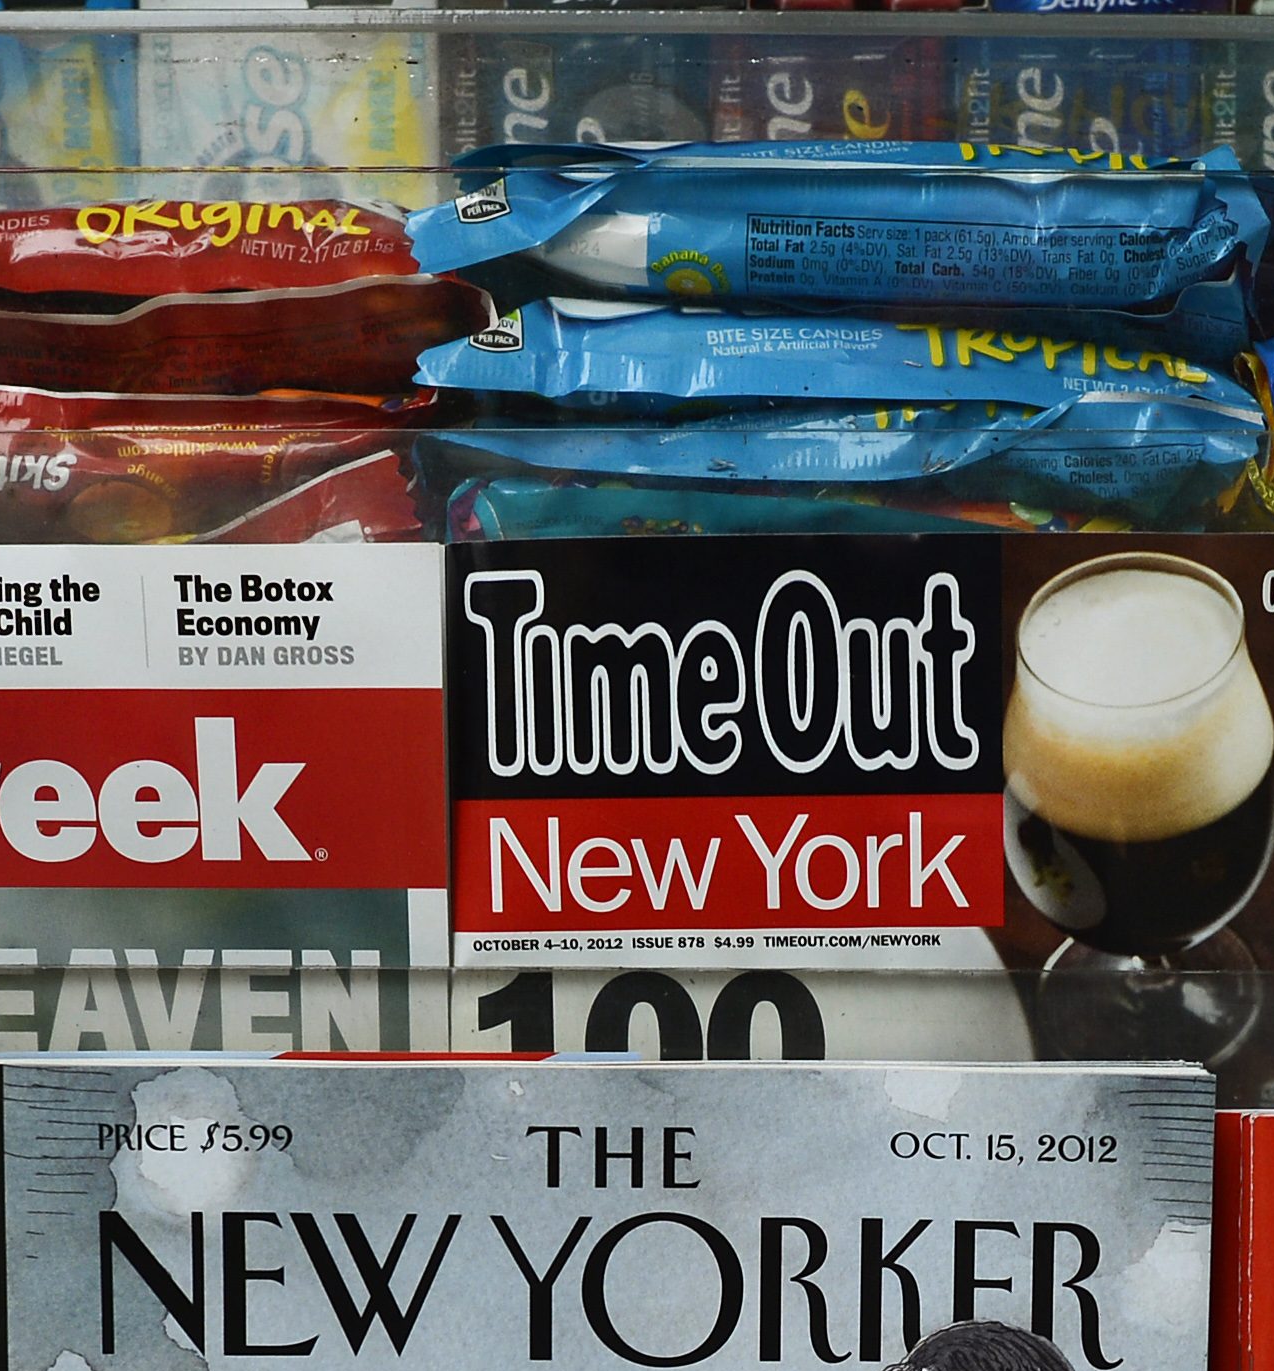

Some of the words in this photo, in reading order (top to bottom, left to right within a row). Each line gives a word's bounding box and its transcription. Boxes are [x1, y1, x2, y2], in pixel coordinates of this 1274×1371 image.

[750, 220, 813, 237] Nutrition
[816, 222, 855, 239] Facts
[707, 330, 745, 345] BITE
[752, 328, 793, 341] SIZE
[799, 327, 883, 342] CANDIES
[49, 575, 100, 602] the
[174, 574, 233, 602] The
[240, 574, 334, 602] Botox
[177, 608, 321, 640] Economy
[178, 645, 208, 666] BY
[217, 645, 266, 666] DAN
[273, 645, 355, 666] GROSS
[489, 816, 722, 913] New
[734, 811, 970, 911] York
[473, 938, 540, 952] OCTOBER
[587, 938, 623, 952] 2012
[632, 937, 674, 950] ISSUE
[678, 937, 705, 950] 878
[714, 936, 755, 950] $4.99
[763, 934, 942, 949] TIMEOUT.COM/NEWYORK
[97, 1124, 187, 1151] PRICE
[200, 1121, 293, 1154] $5.99
[890, 1131, 972, 1160] OCT.
[986, 1134, 1024, 1165] 15,
[1038, 1134, 1118, 1164] 2012
[526, 1125, 701, 1190] THE
[99, 1211, 462, 1357] NEW
[490, 1212, 1123, 1370] YORKER
